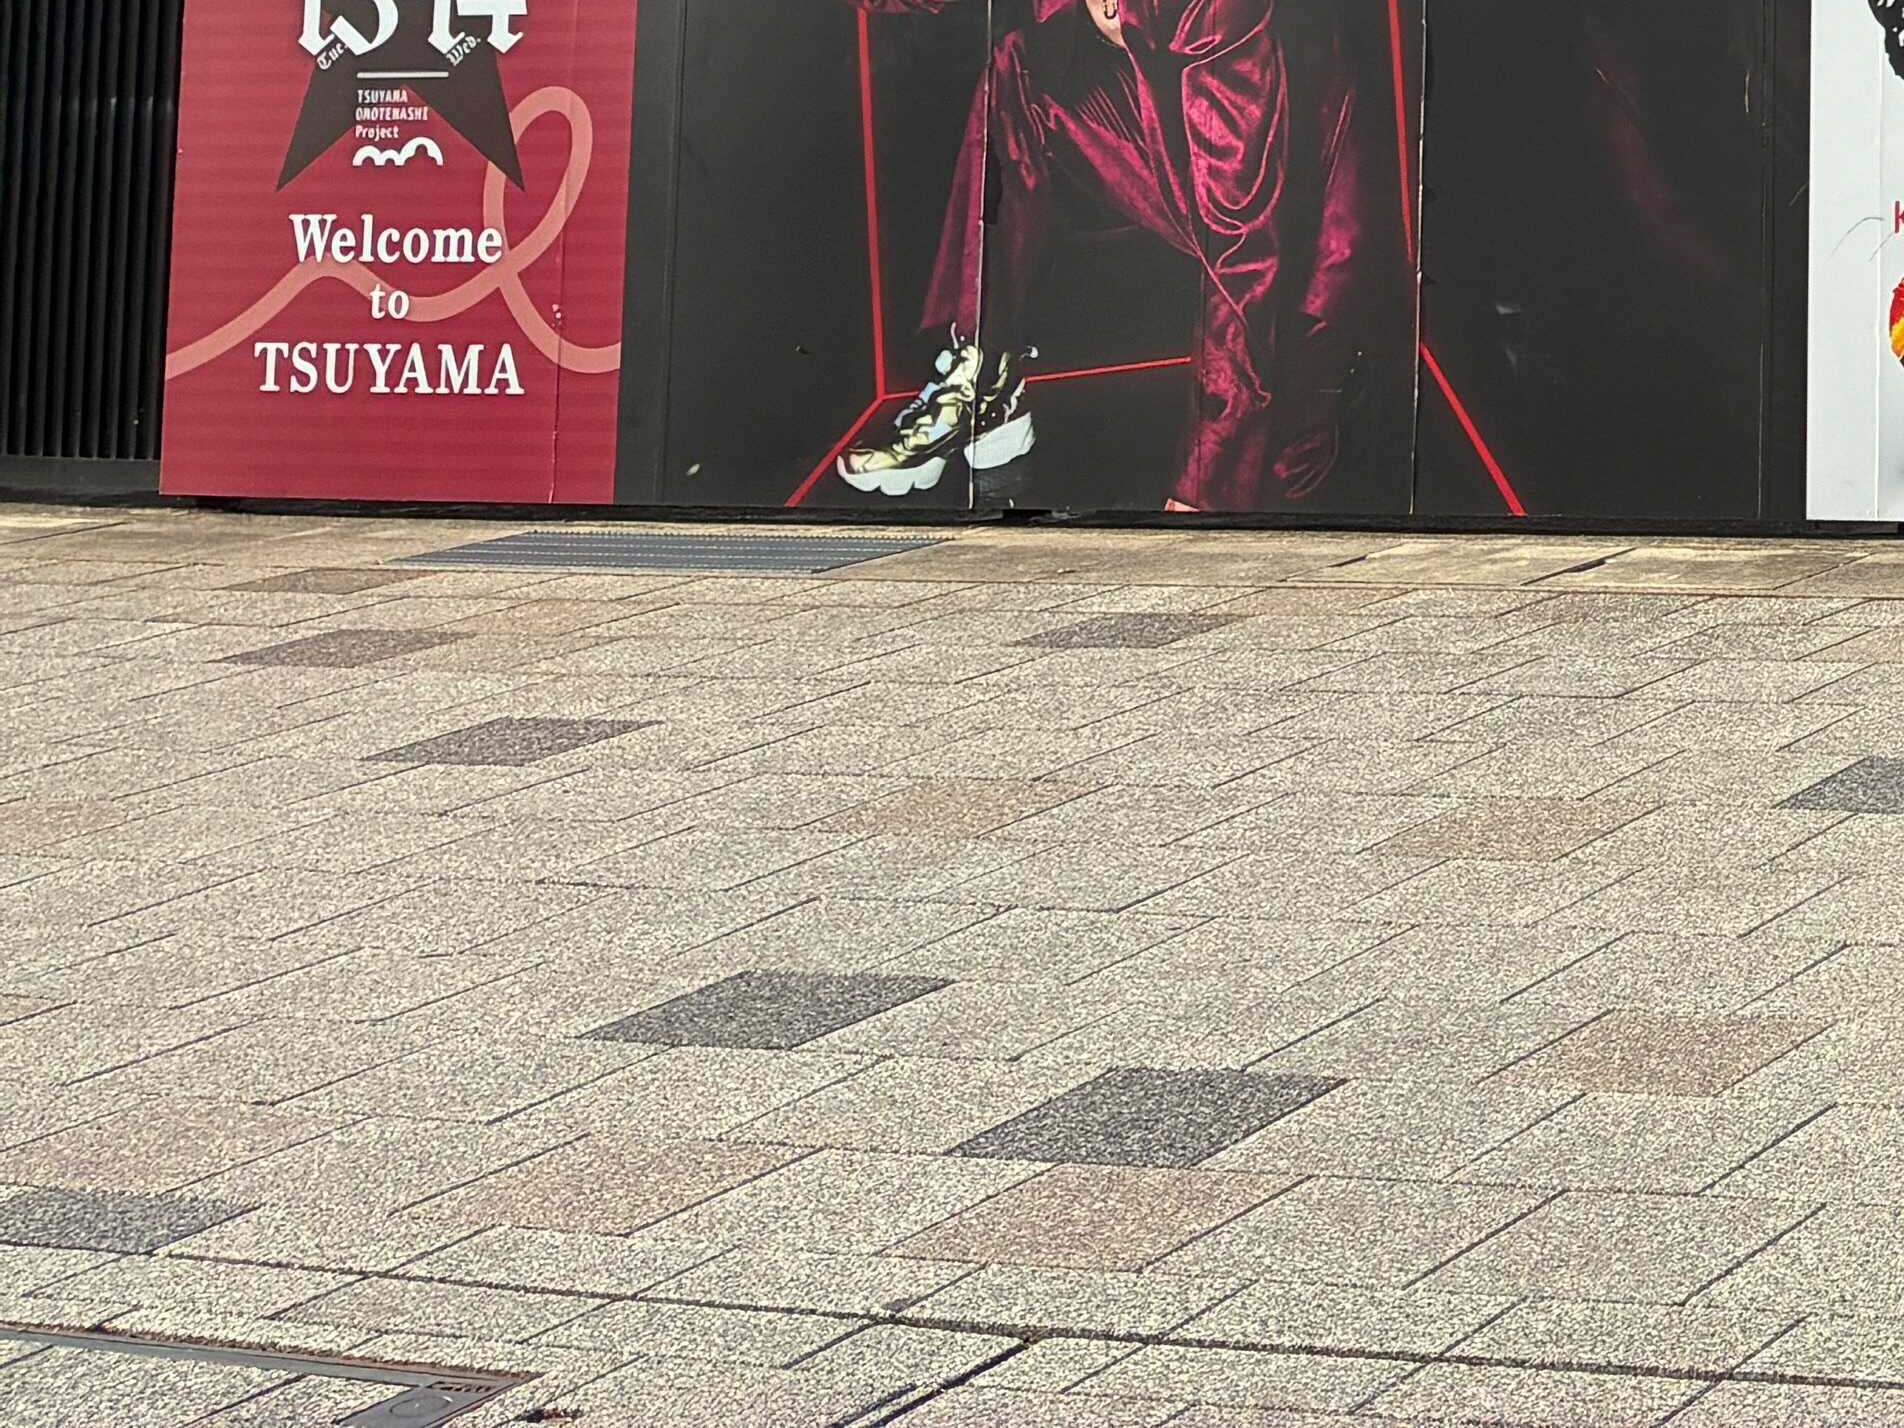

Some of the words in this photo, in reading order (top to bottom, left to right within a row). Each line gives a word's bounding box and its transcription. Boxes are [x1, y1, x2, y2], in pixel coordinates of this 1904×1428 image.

[357, 89, 408, 104] TSUYAMA
[355, 106, 428, 121] OMOTENASHI
[355, 124, 399, 142] Project
[289, 213, 503, 264] Welcome
[369, 282, 410, 320] to
[254, 341, 525, 396] TSUYAMA
